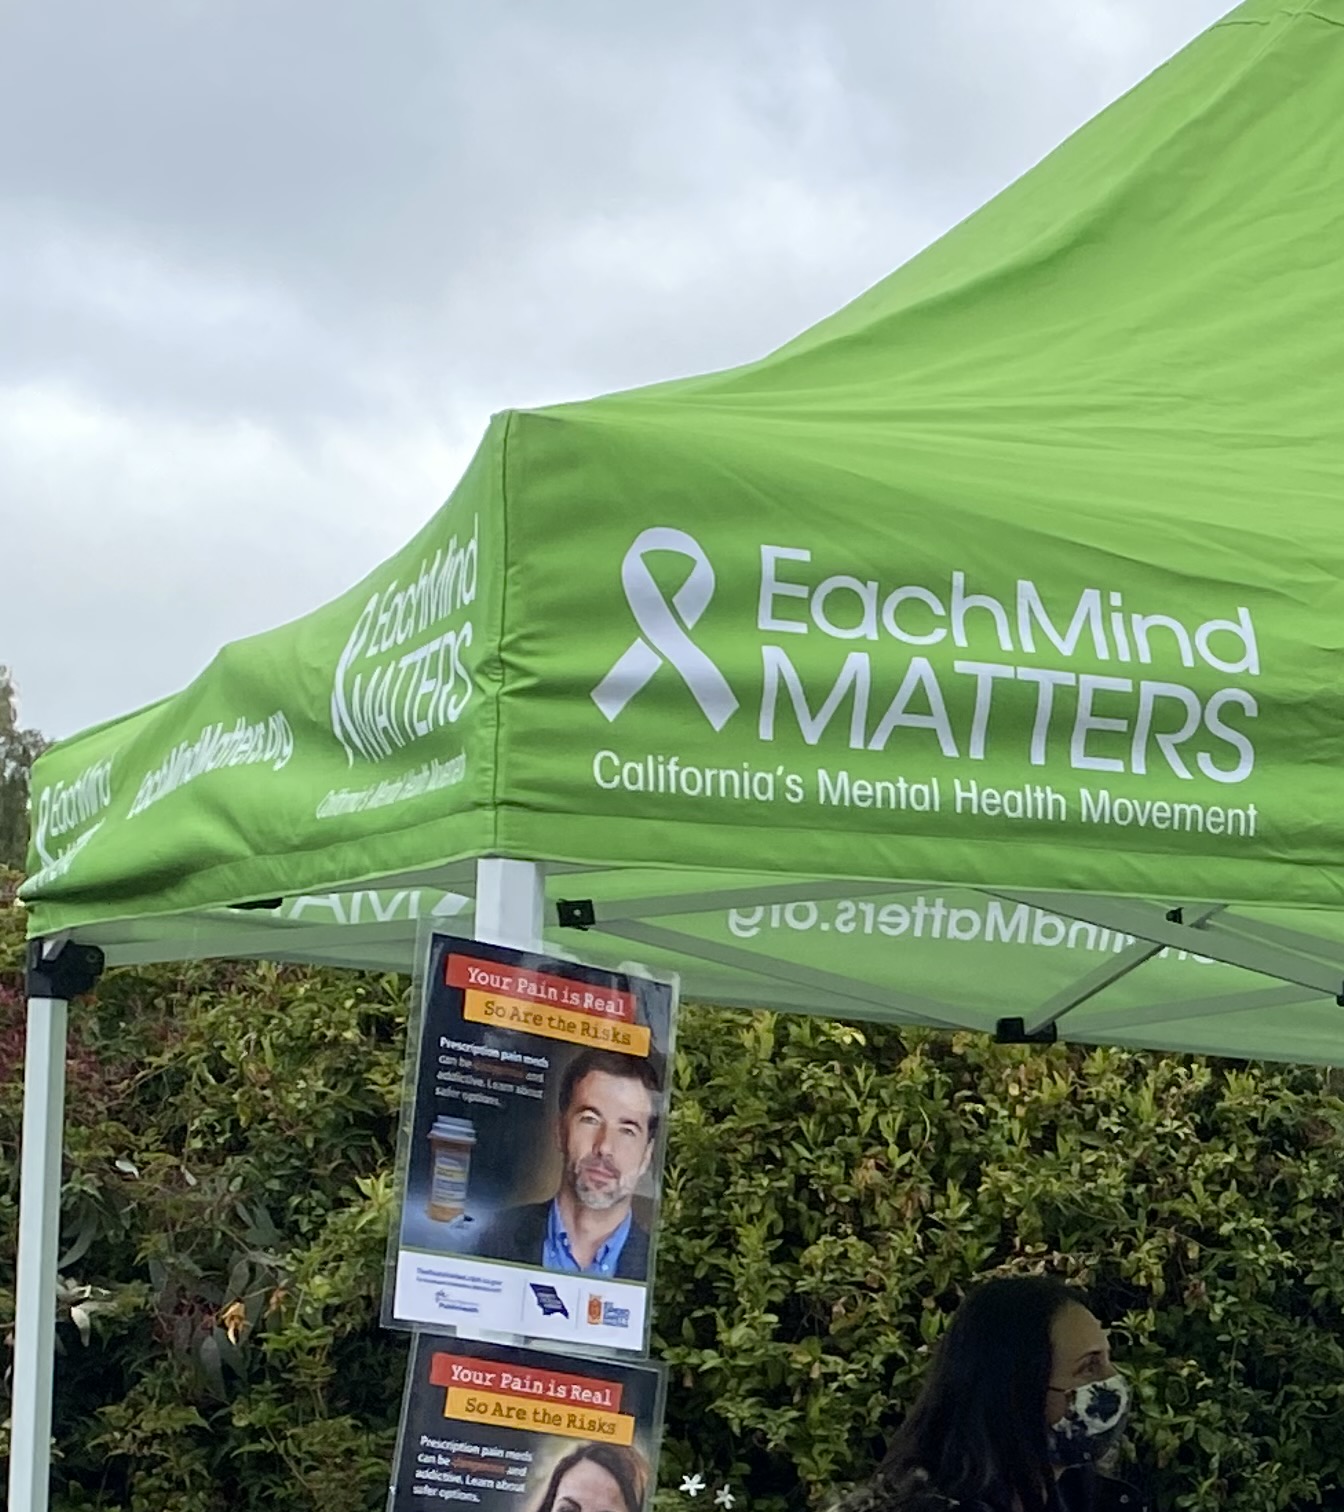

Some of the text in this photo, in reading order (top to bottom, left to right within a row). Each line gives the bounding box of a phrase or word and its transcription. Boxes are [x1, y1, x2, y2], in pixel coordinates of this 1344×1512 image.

[757, 544, 1260, 676] EachMind
[352, 621, 472, 763] MATTERS
[757, 645, 1259, 784] MATTERS
[592, 750, 1258, 837] California's Mental Health Movement
[467, 967, 625, 1016] Your Pain is Real
[484, 1001, 631, 1046] So Are the Risks
[451, 1364, 613, 1407] Your Pain is Real
[464, 1397, 616, 1436] So Are the Risks
